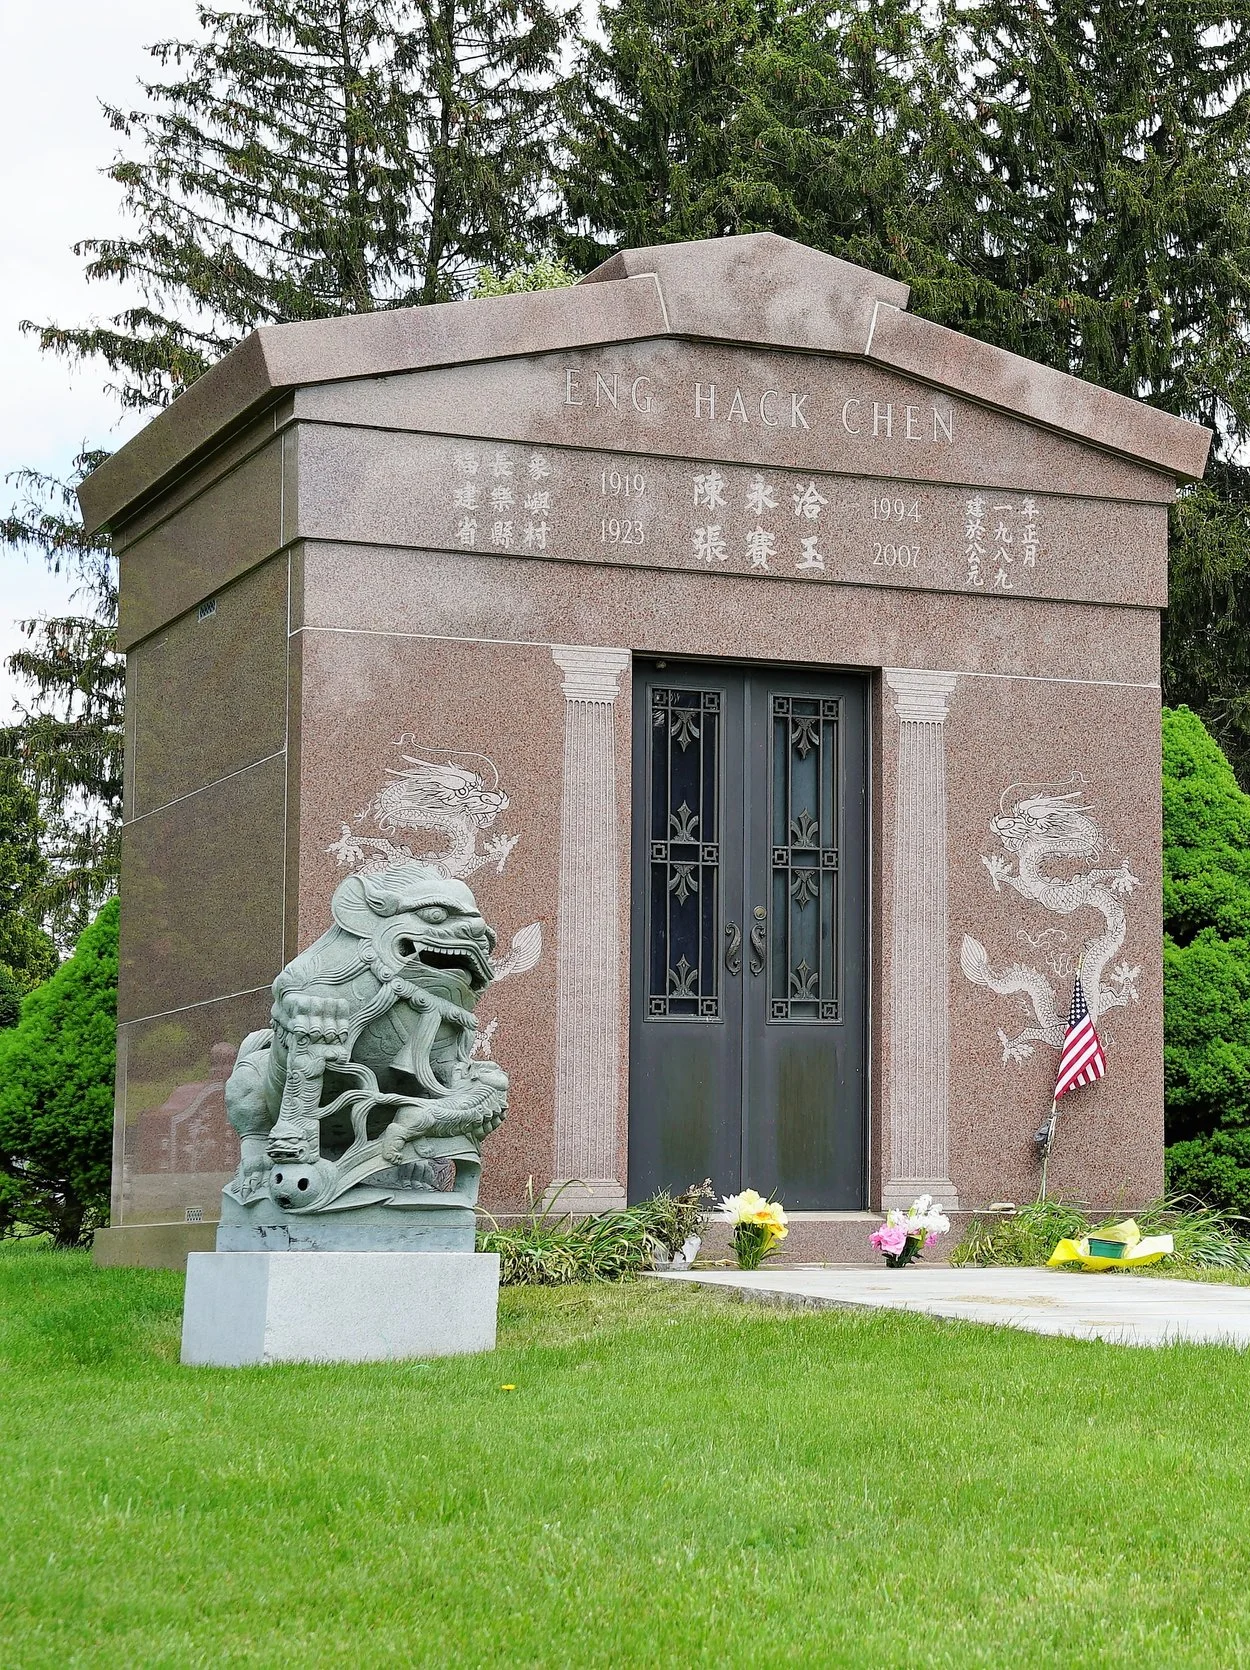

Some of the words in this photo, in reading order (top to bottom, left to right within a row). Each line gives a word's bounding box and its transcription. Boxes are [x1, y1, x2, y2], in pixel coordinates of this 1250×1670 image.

[563, 368, 653, 414] ENG
[693, 381, 812, 430] HACK
[841, 398, 955, 444] CHEN
[600, 469, 646, 498] 1919
[872, 497, 922, 523] 1994
[600, 518, 645, 545] 1923
[1020, 497, 1040, 568] 年正月
[872, 542, 921, 568] 2007
[992, 504, 1014, 590] 一九八九
